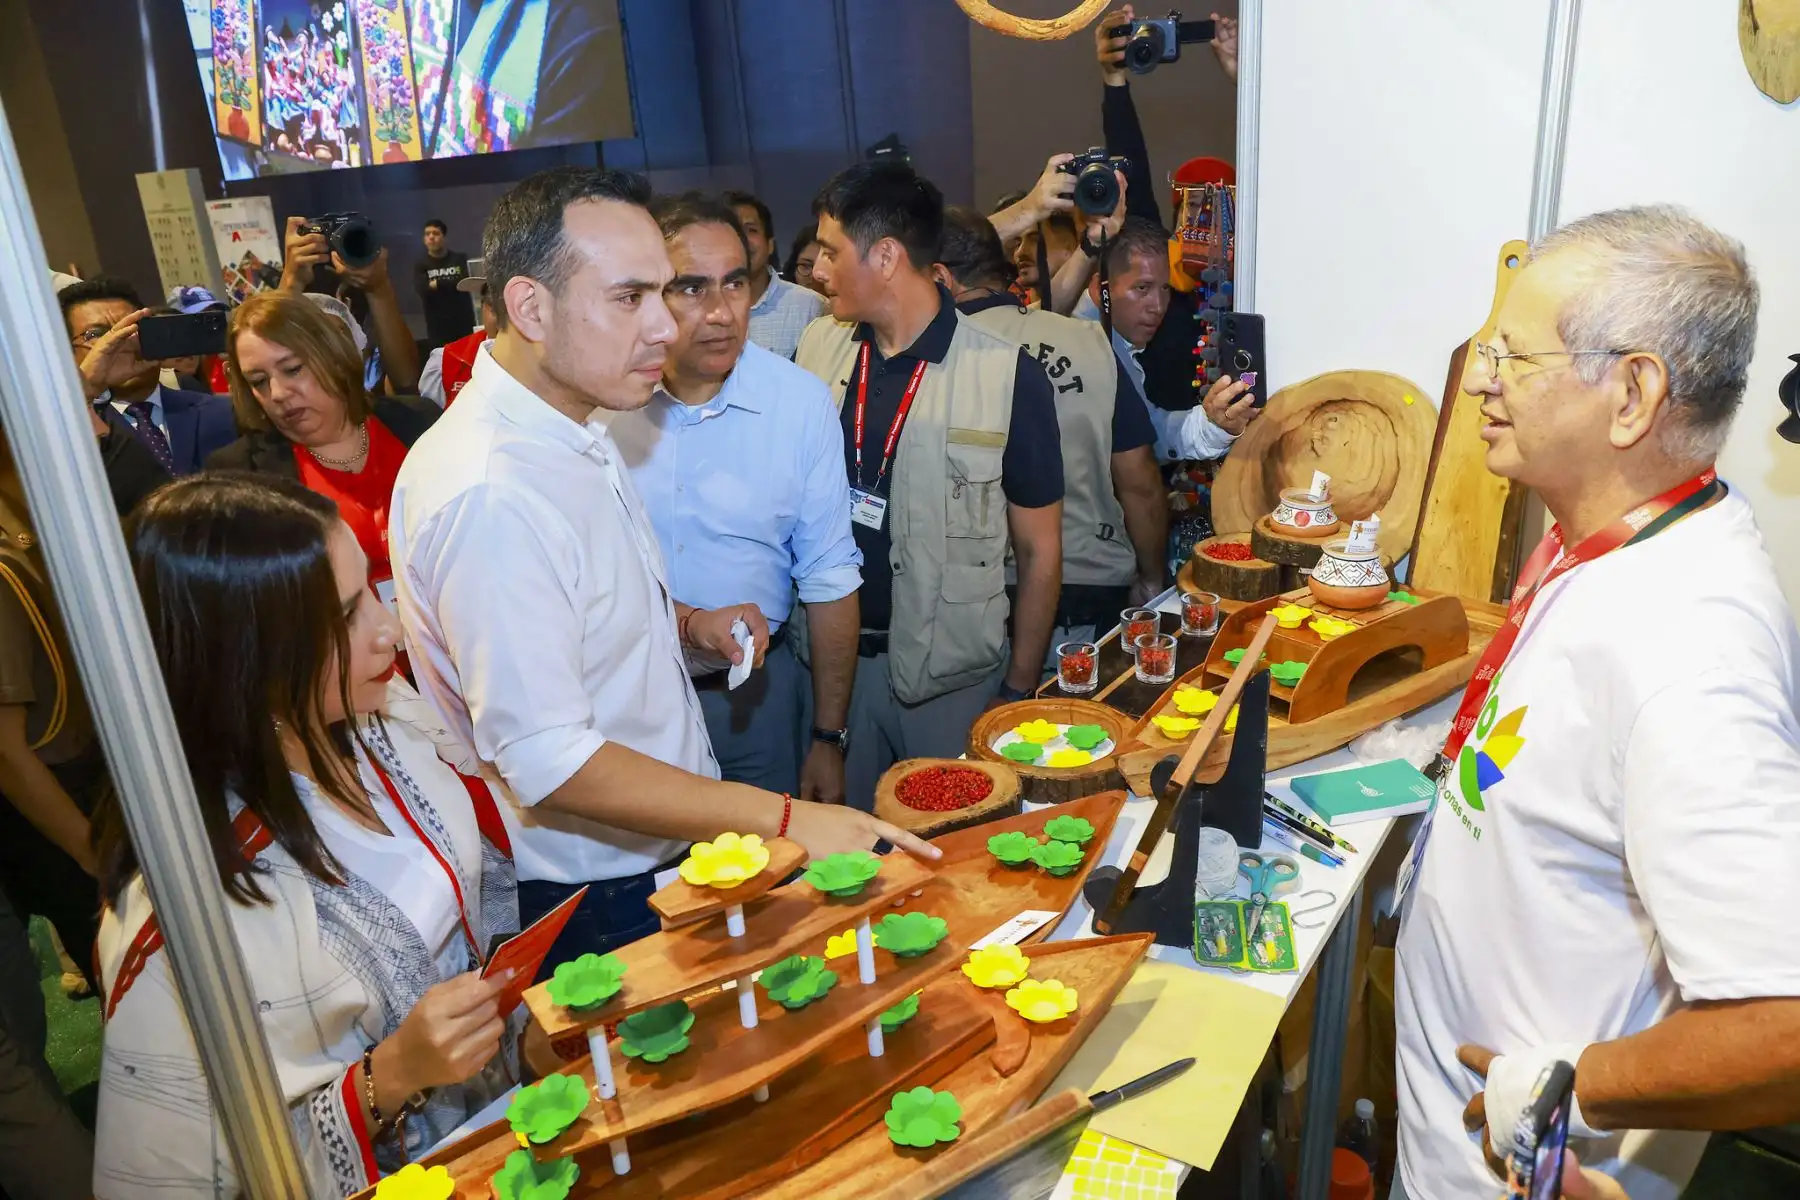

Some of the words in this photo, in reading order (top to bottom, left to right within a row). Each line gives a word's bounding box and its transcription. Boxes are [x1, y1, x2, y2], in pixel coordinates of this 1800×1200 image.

[1021, 342, 1084, 394] EST
[1461, 815, 1472, 831] en
[1473, 826, 1482, 841] ti
